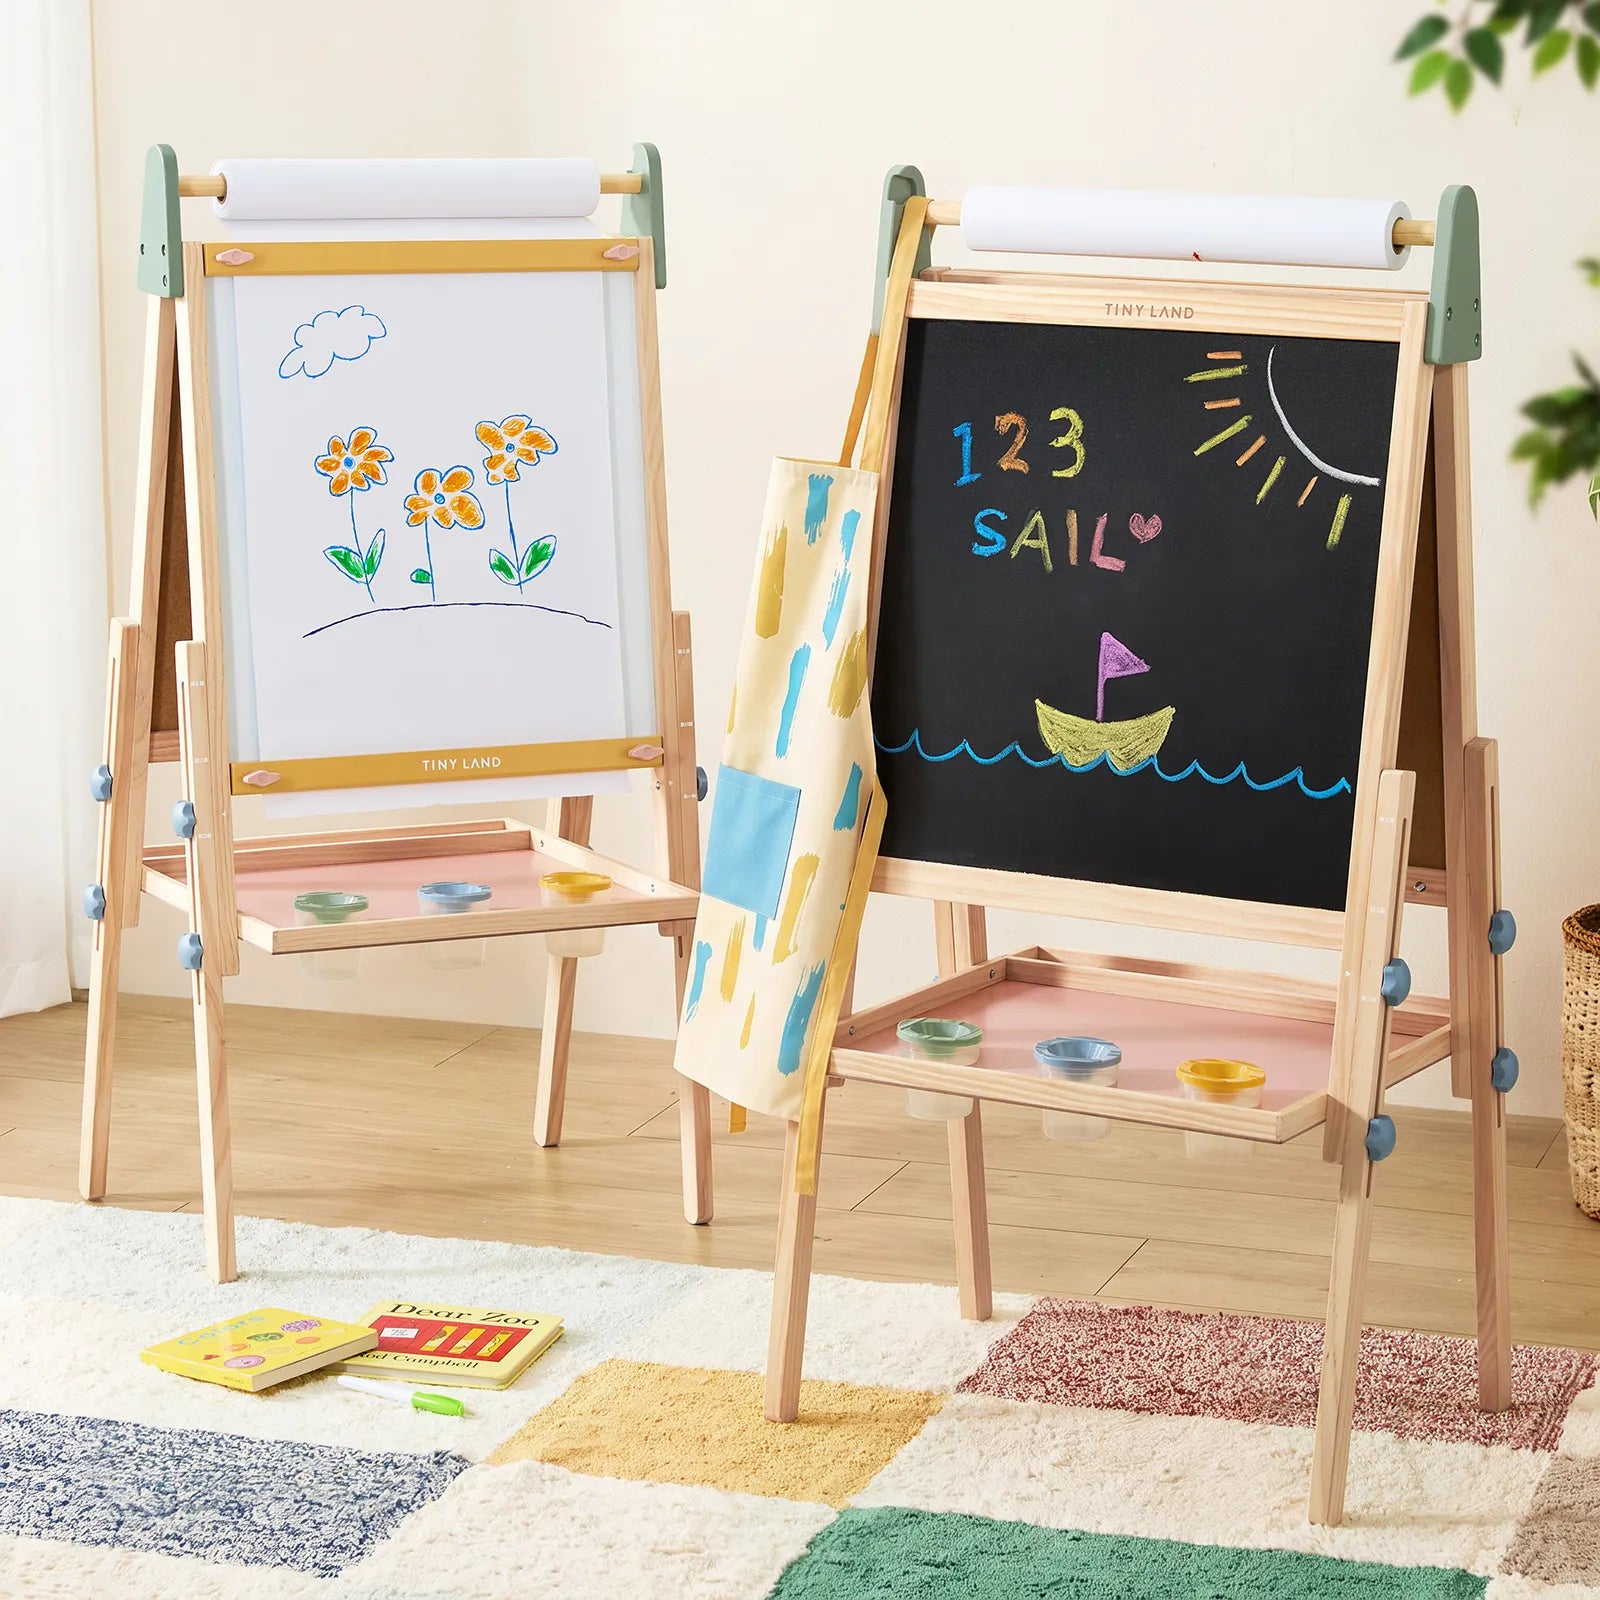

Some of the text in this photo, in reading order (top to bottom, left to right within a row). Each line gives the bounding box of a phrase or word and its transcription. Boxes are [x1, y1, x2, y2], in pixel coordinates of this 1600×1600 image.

[1105, 303, 1194, 319] TINY LAND
[972, 508, 1126, 572] SAIL
[422, 756, 501, 771] TINY LAND
[388, 1303, 540, 1326] Dear Zoo
[393, 1355, 479, 1368] Campbell
